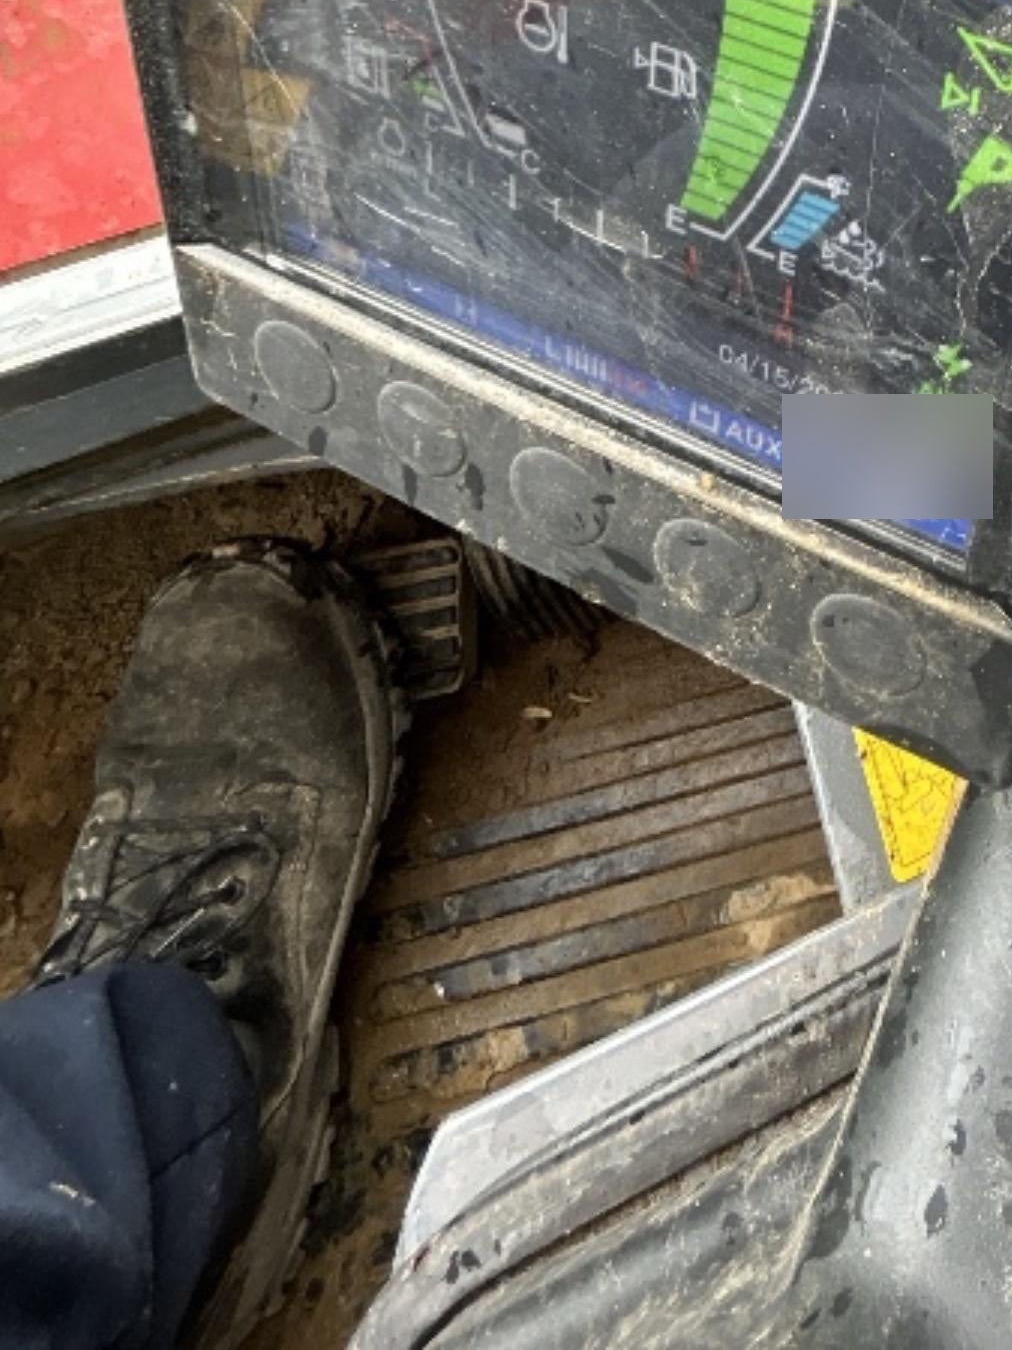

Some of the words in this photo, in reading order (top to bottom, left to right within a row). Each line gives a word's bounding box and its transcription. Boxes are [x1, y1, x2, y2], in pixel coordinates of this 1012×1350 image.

[520, 149, 542, 175] C
[666, 203, 688, 235] E
[778, 250, 798, 276] E
